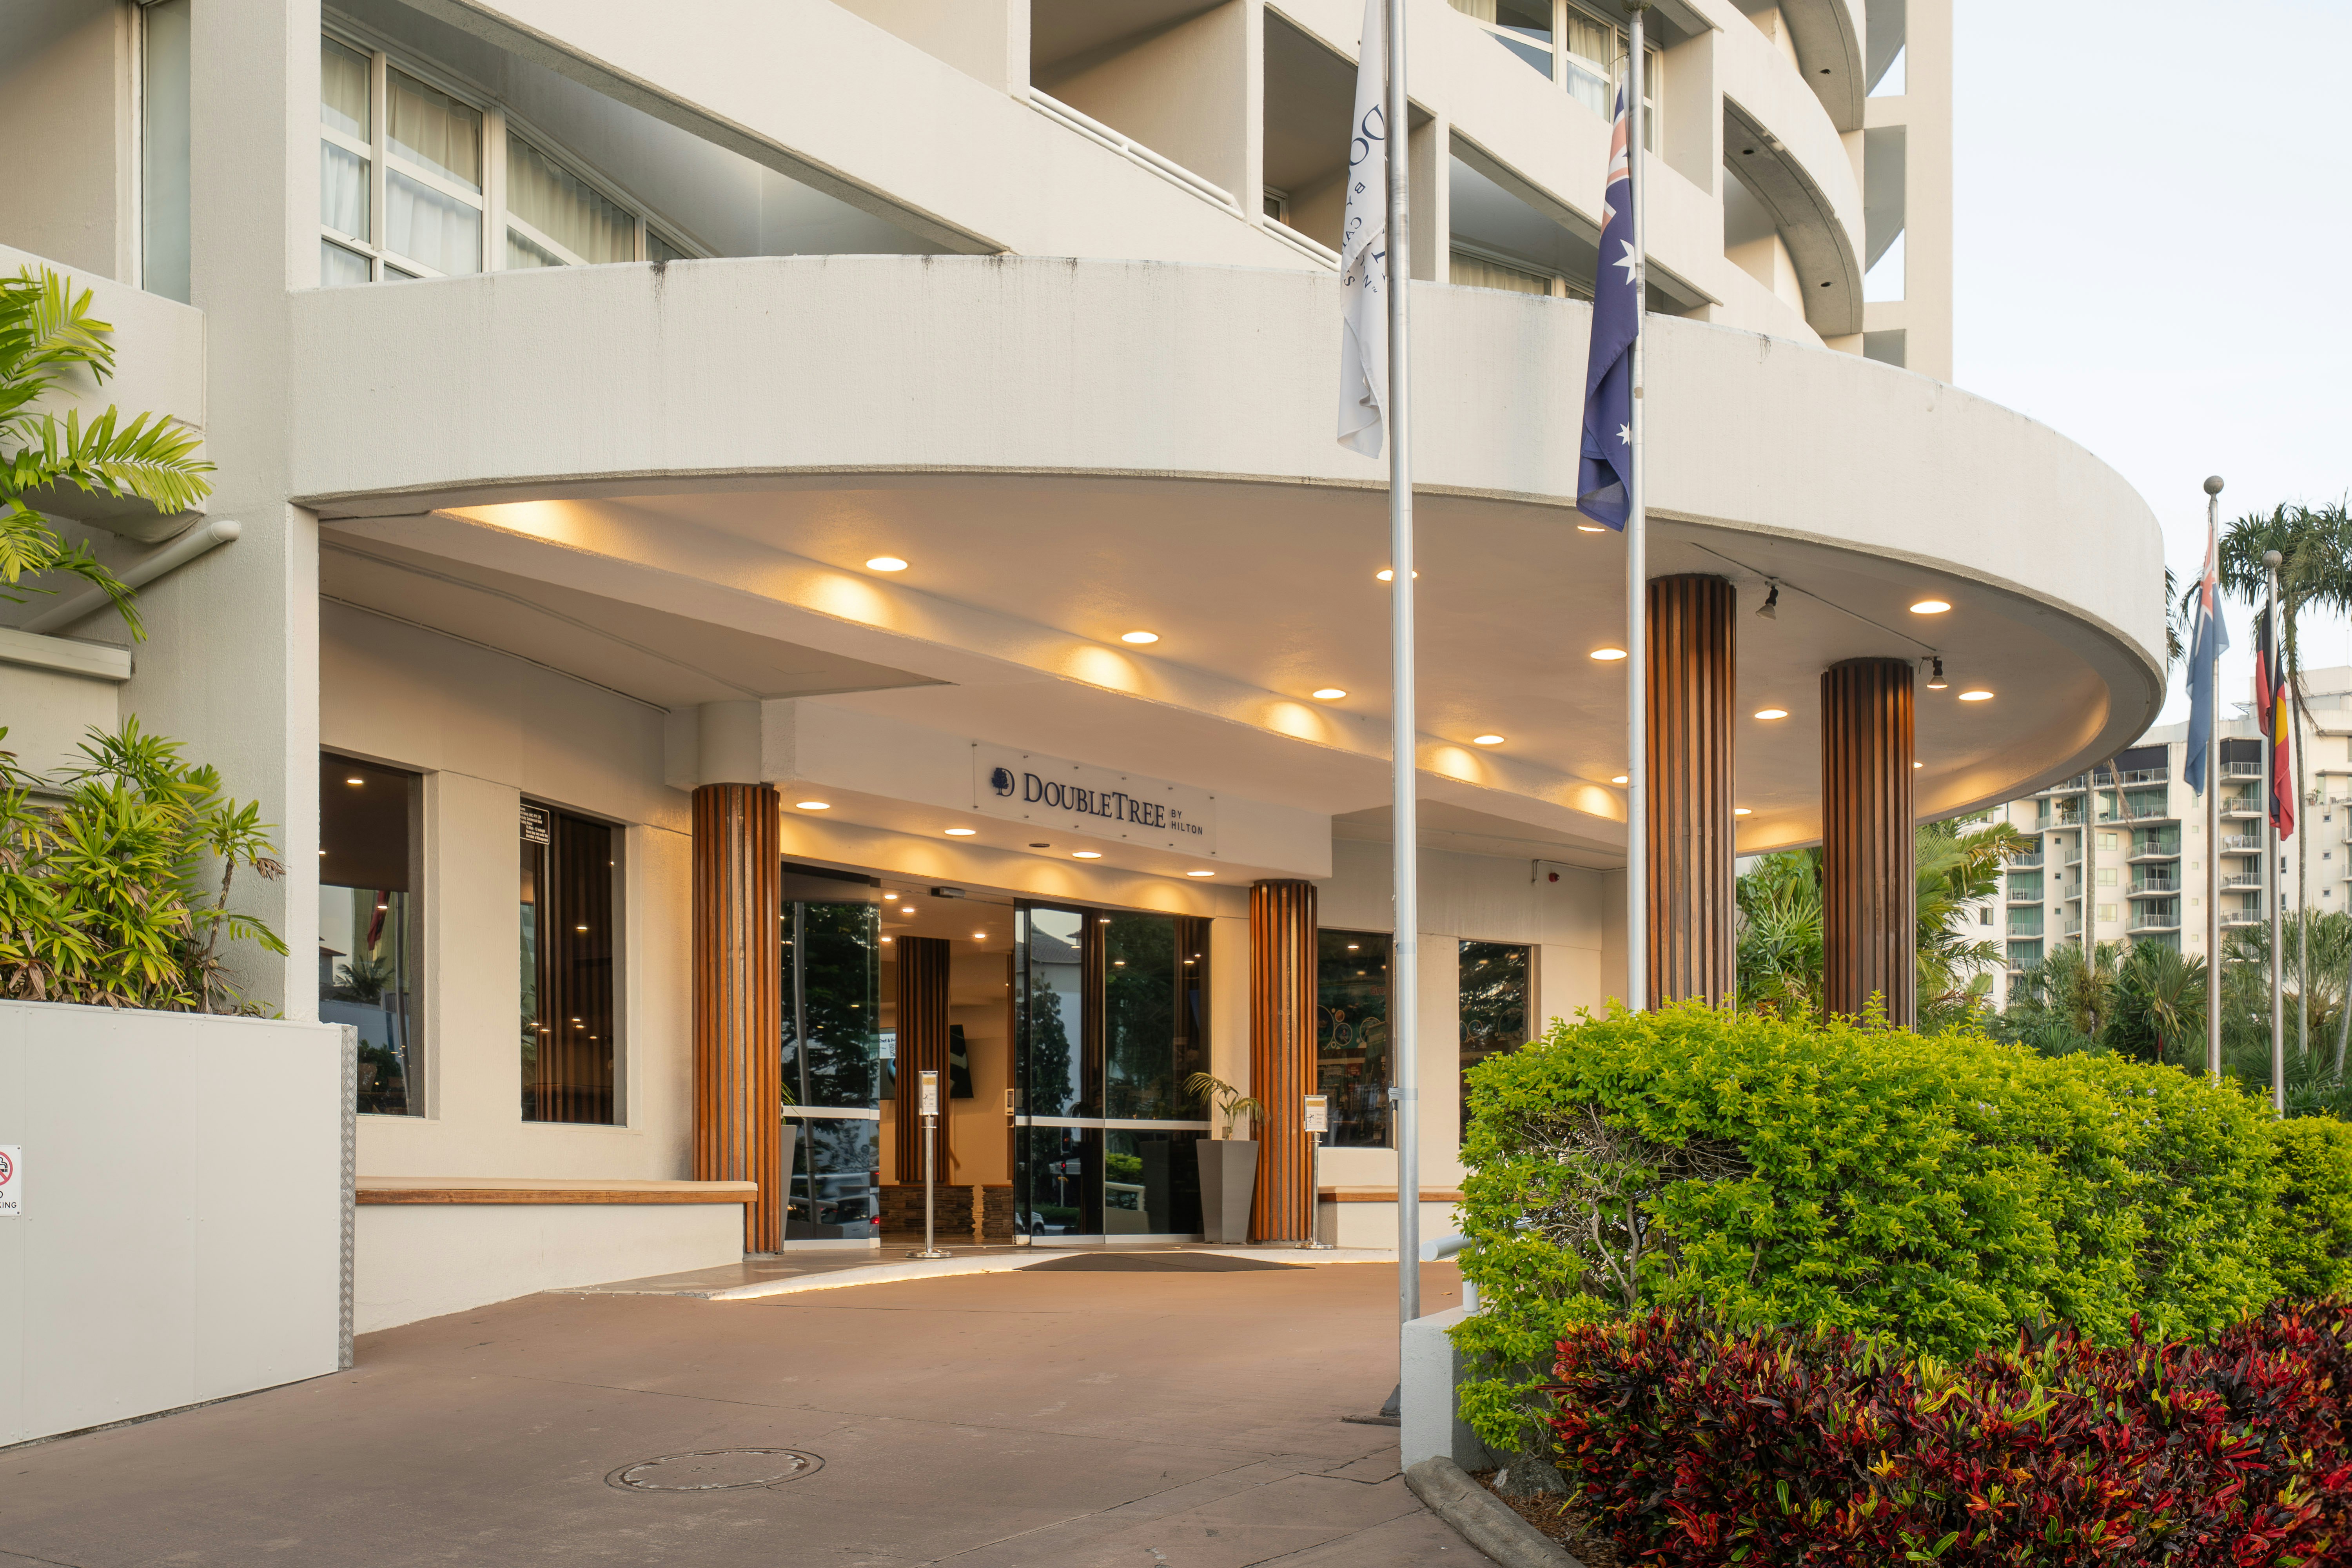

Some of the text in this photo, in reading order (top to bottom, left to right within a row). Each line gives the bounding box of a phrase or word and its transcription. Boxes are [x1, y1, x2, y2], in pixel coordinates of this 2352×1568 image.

[1346, 181, 1366, 207] BY
[1171, 809, 1182, 818] BY
[1171, 820, 1203, 835] HILTON
